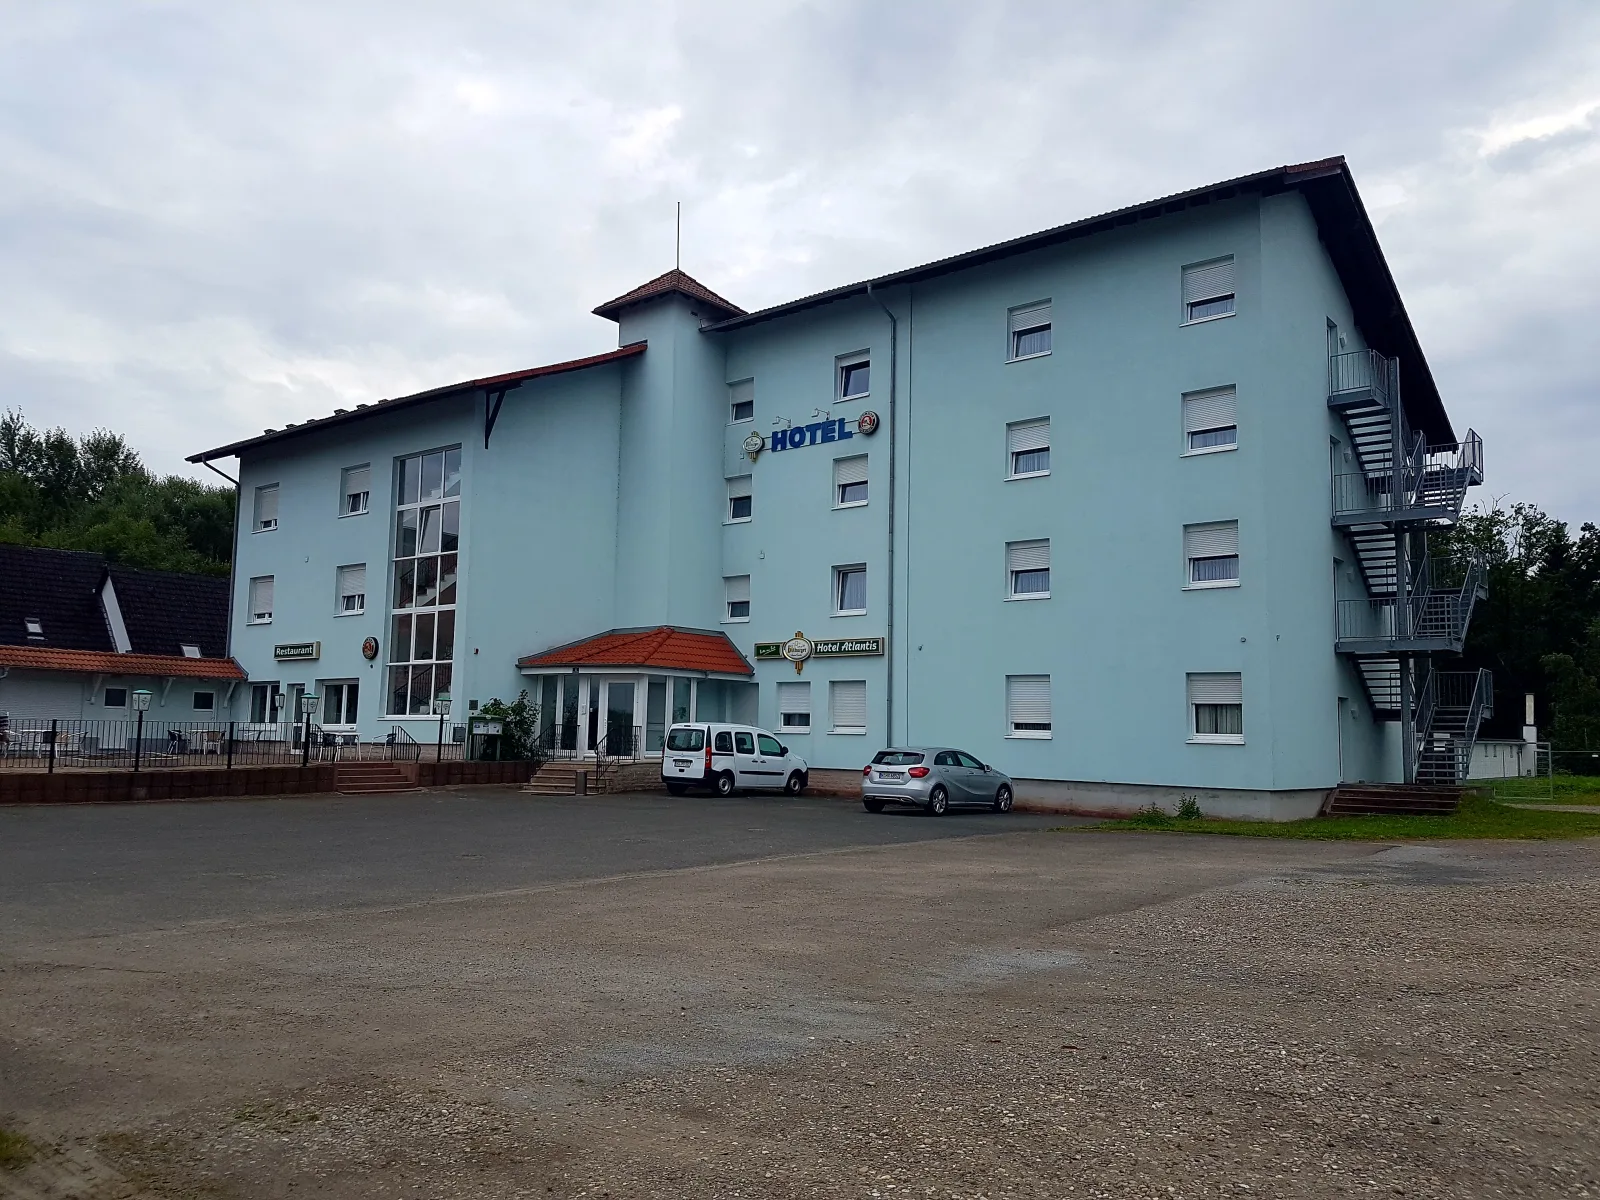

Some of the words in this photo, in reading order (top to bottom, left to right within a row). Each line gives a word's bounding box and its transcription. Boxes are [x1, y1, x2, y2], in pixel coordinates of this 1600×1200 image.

[771, 418, 853, 452] HOTEL
[276, 645, 313, 656] Restaurant
[816, 642, 840, 652] Hotel
[841, 640, 877, 651] Atlantis
